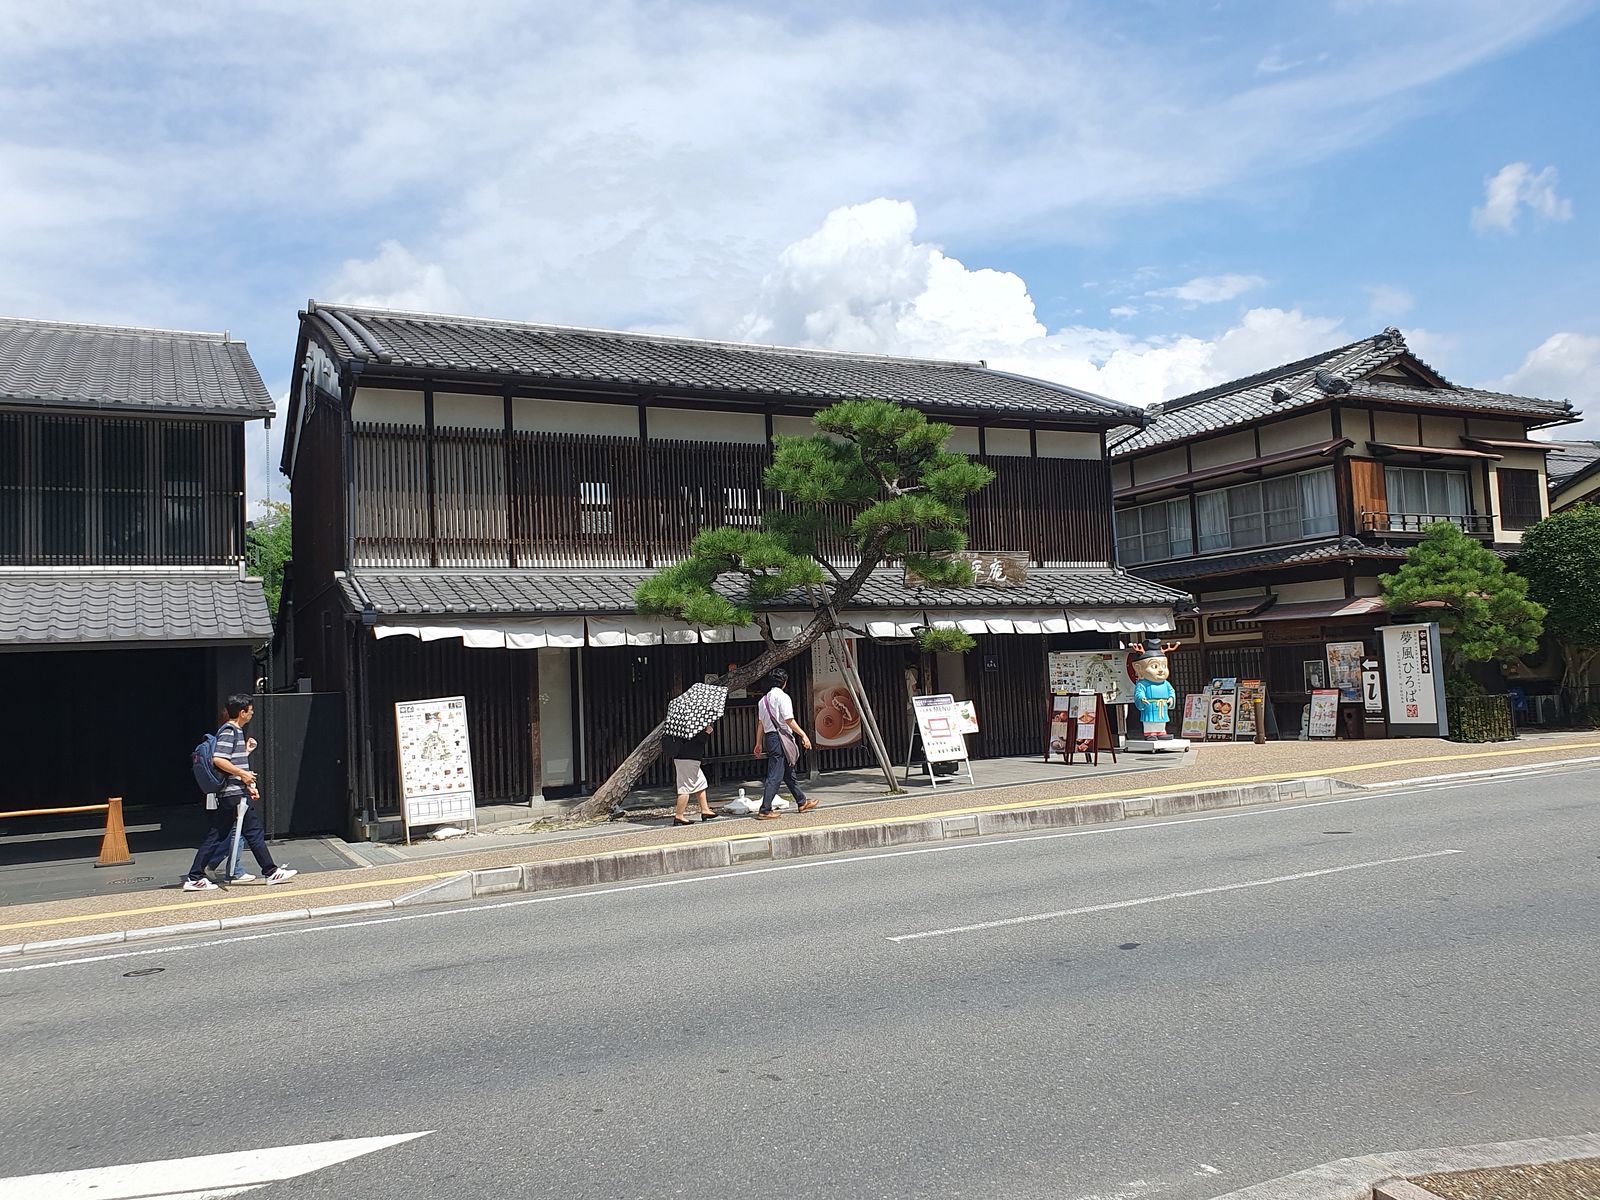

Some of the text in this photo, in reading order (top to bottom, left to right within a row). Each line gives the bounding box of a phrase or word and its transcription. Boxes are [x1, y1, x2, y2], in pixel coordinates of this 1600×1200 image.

[1400, 631, 1417, 703] 夢風ひろば
